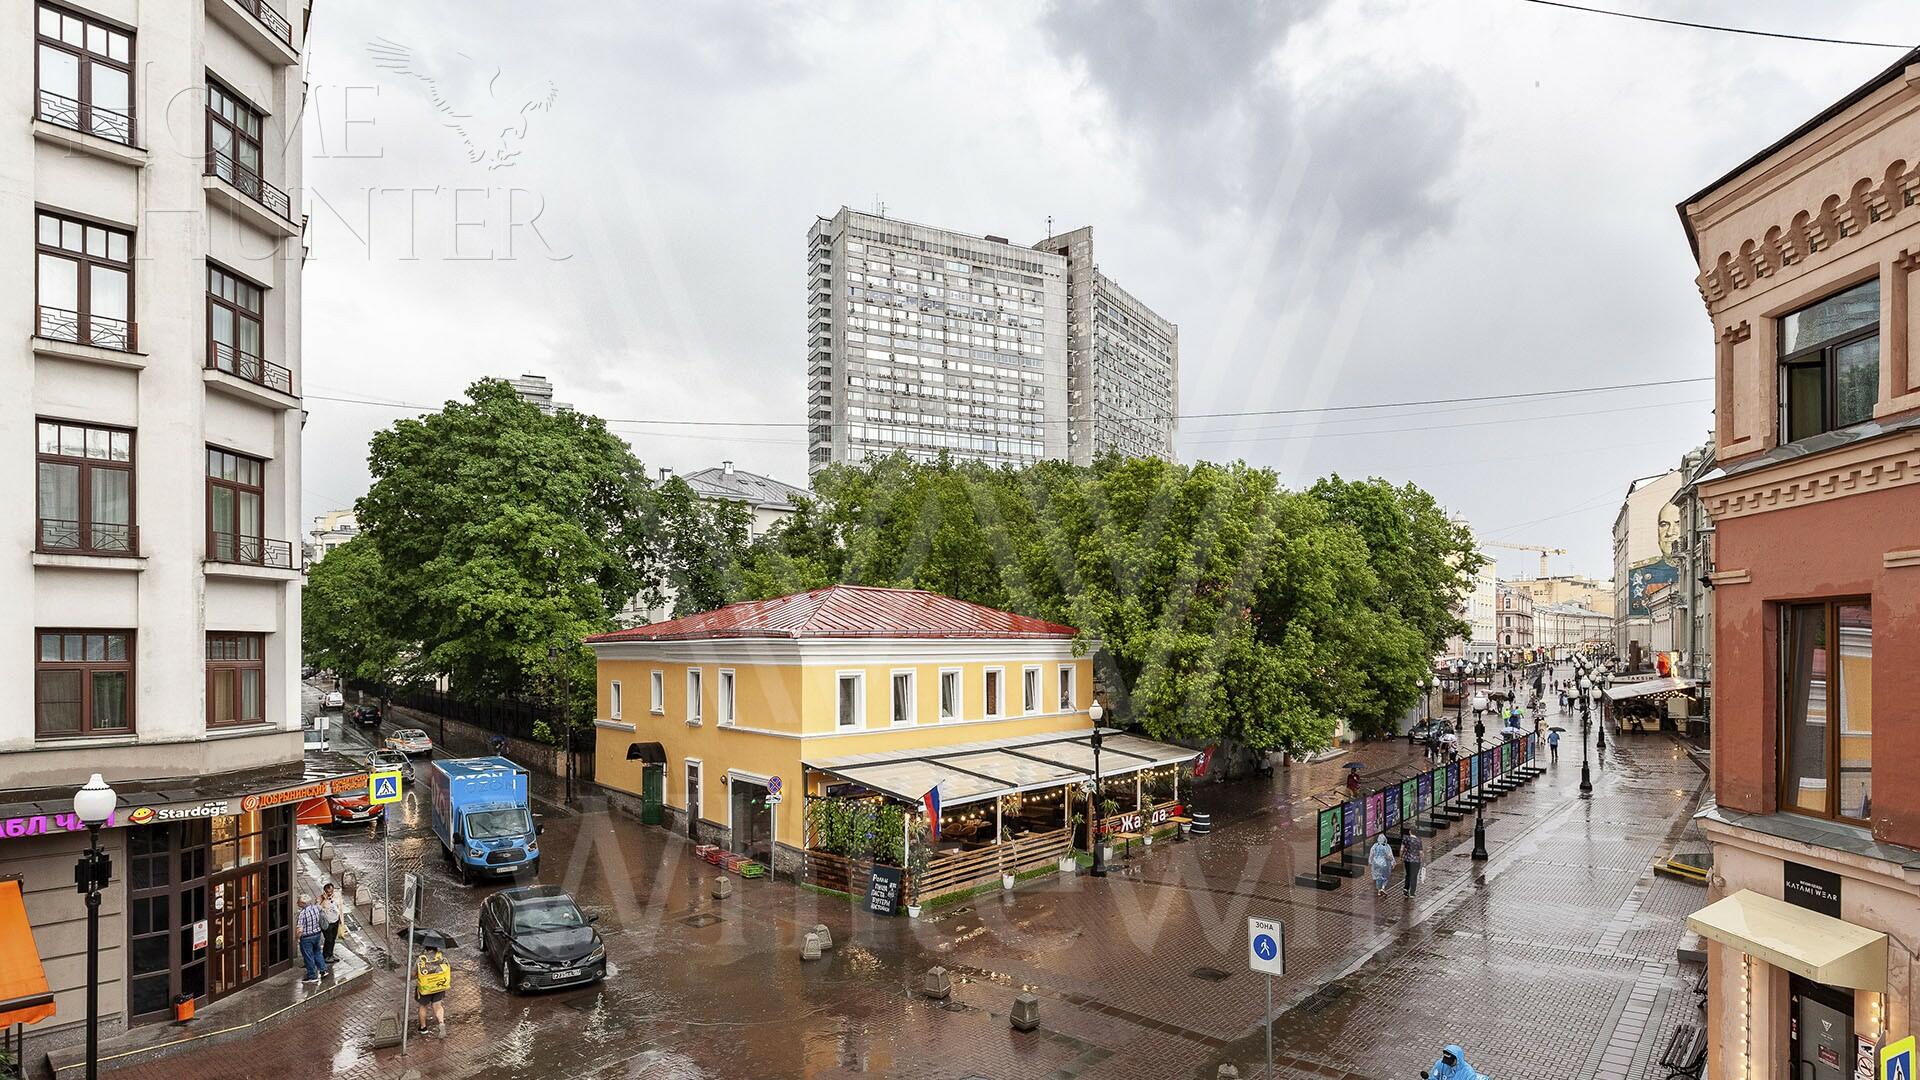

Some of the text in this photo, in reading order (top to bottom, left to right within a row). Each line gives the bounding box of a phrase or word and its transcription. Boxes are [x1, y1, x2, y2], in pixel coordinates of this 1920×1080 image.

[260, 781, 327, 807] ДОБРЫНИНСКИЙ
[158, 805, 228, 820] Stardogs
[1120, 808, 1166, 833] Жада
[1785, 880, 1814, 896] KATAMI
[1815, 889, 1838, 902] WEAR
[1255, 921, 1274, 930] ЗОНА
